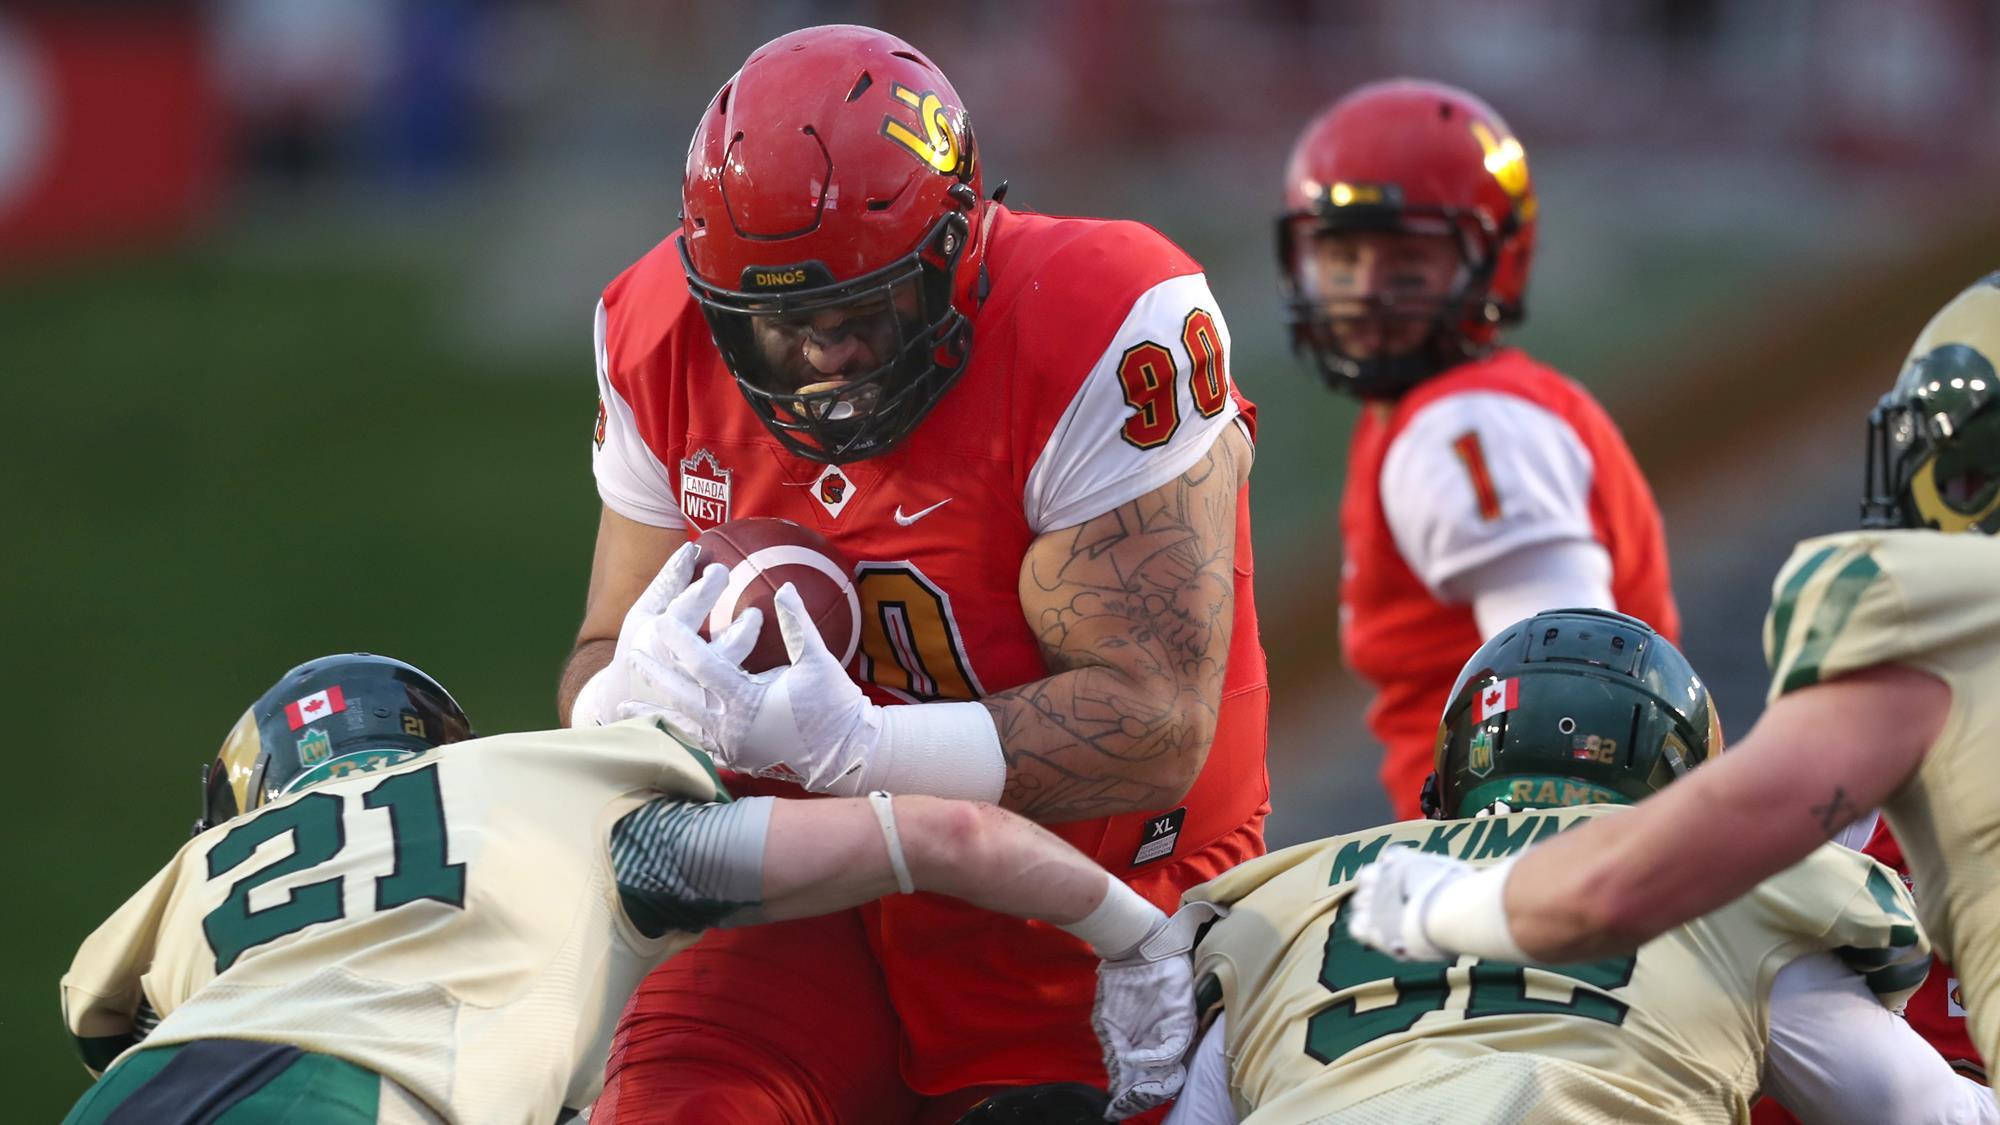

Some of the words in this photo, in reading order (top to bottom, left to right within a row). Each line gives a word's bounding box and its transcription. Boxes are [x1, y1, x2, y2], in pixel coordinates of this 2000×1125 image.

[756, 270, 806, 286] DINOS
[1116, 307, 1228, 451] 90
[686, 476, 725, 499] CANADA
[1453, 431, 1502, 522] 1
[686, 494, 725, 523] WEST
[403, 715, 427, 738] 21
[1152, 817, 1174, 837] XL
[202, 762, 467, 976] 21
